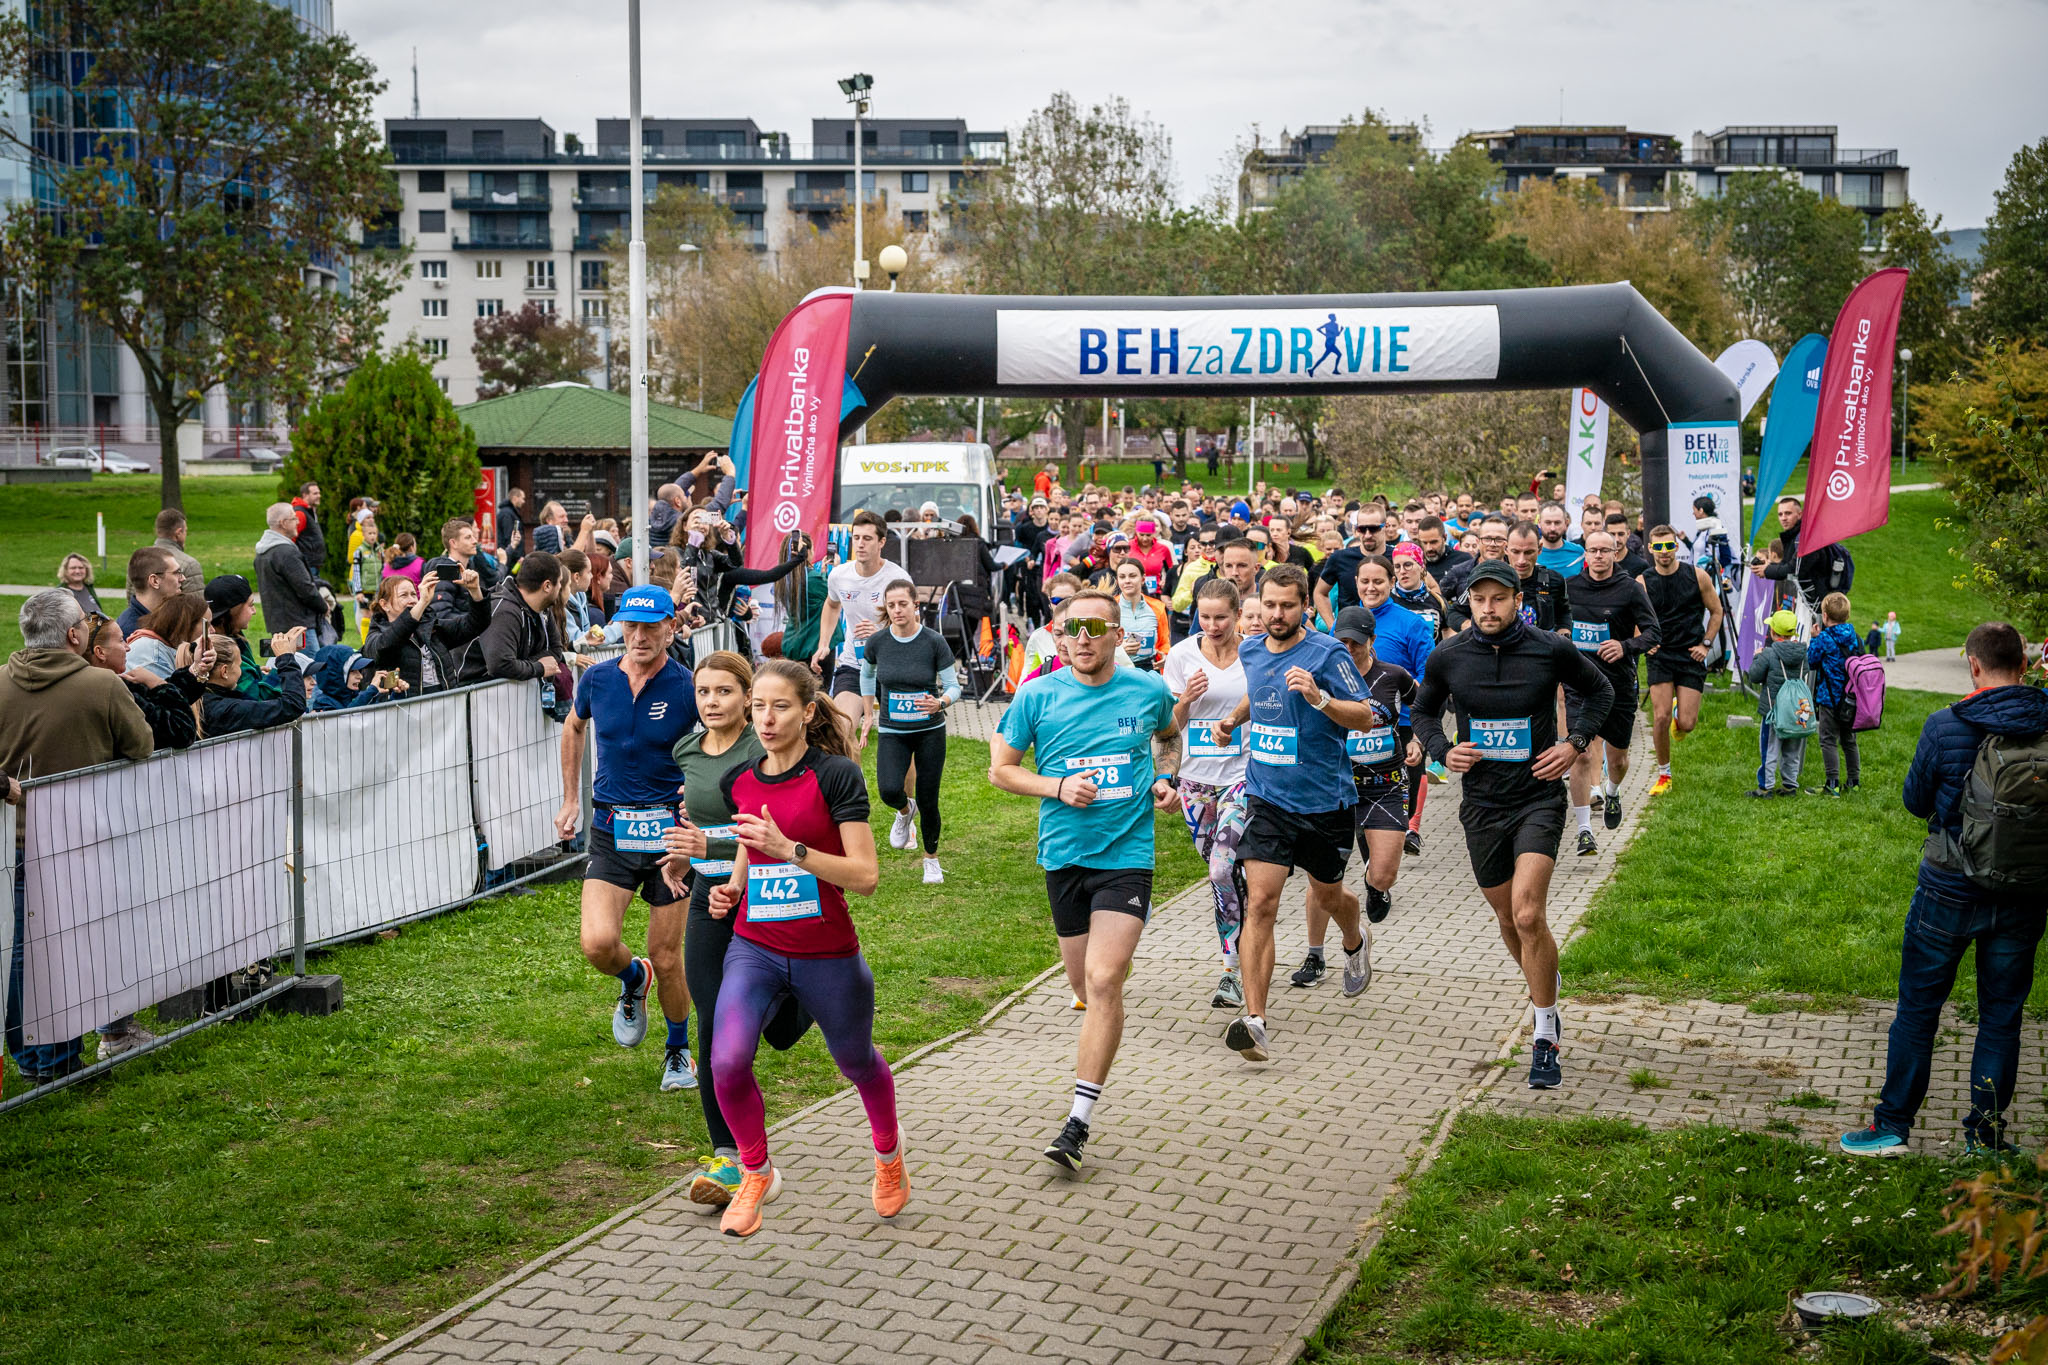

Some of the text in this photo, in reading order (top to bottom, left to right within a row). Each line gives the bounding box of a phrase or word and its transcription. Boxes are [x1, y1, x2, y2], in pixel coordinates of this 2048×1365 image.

[1079, 328, 1179, 375] BEH
[1187, 346, 1223, 374] za
[1805, 379, 1819, 389] OVB
[1835, 318, 1871, 466] Privatbanka
[779, 347, 810, 497] Privatbanka
[1684, 433, 1729, 449] BEH za
[1855, 407, 1868, 467] Výnimočná
[802, 437, 816, 498] Výnimočná
[809, 413, 817, 433] ako
[626, 597, 655, 608] HOKA
[1580, 630, 1600, 641] 391
[1118, 717, 1137, 727] BEH
[1258, 735, 1284, 752] 464
[1356, 737, 1383, 752] 409
[1482, 731, 1517, 747] 376
[627, 821, 661, 837] 483
[760, 878, 800, 900] 442
